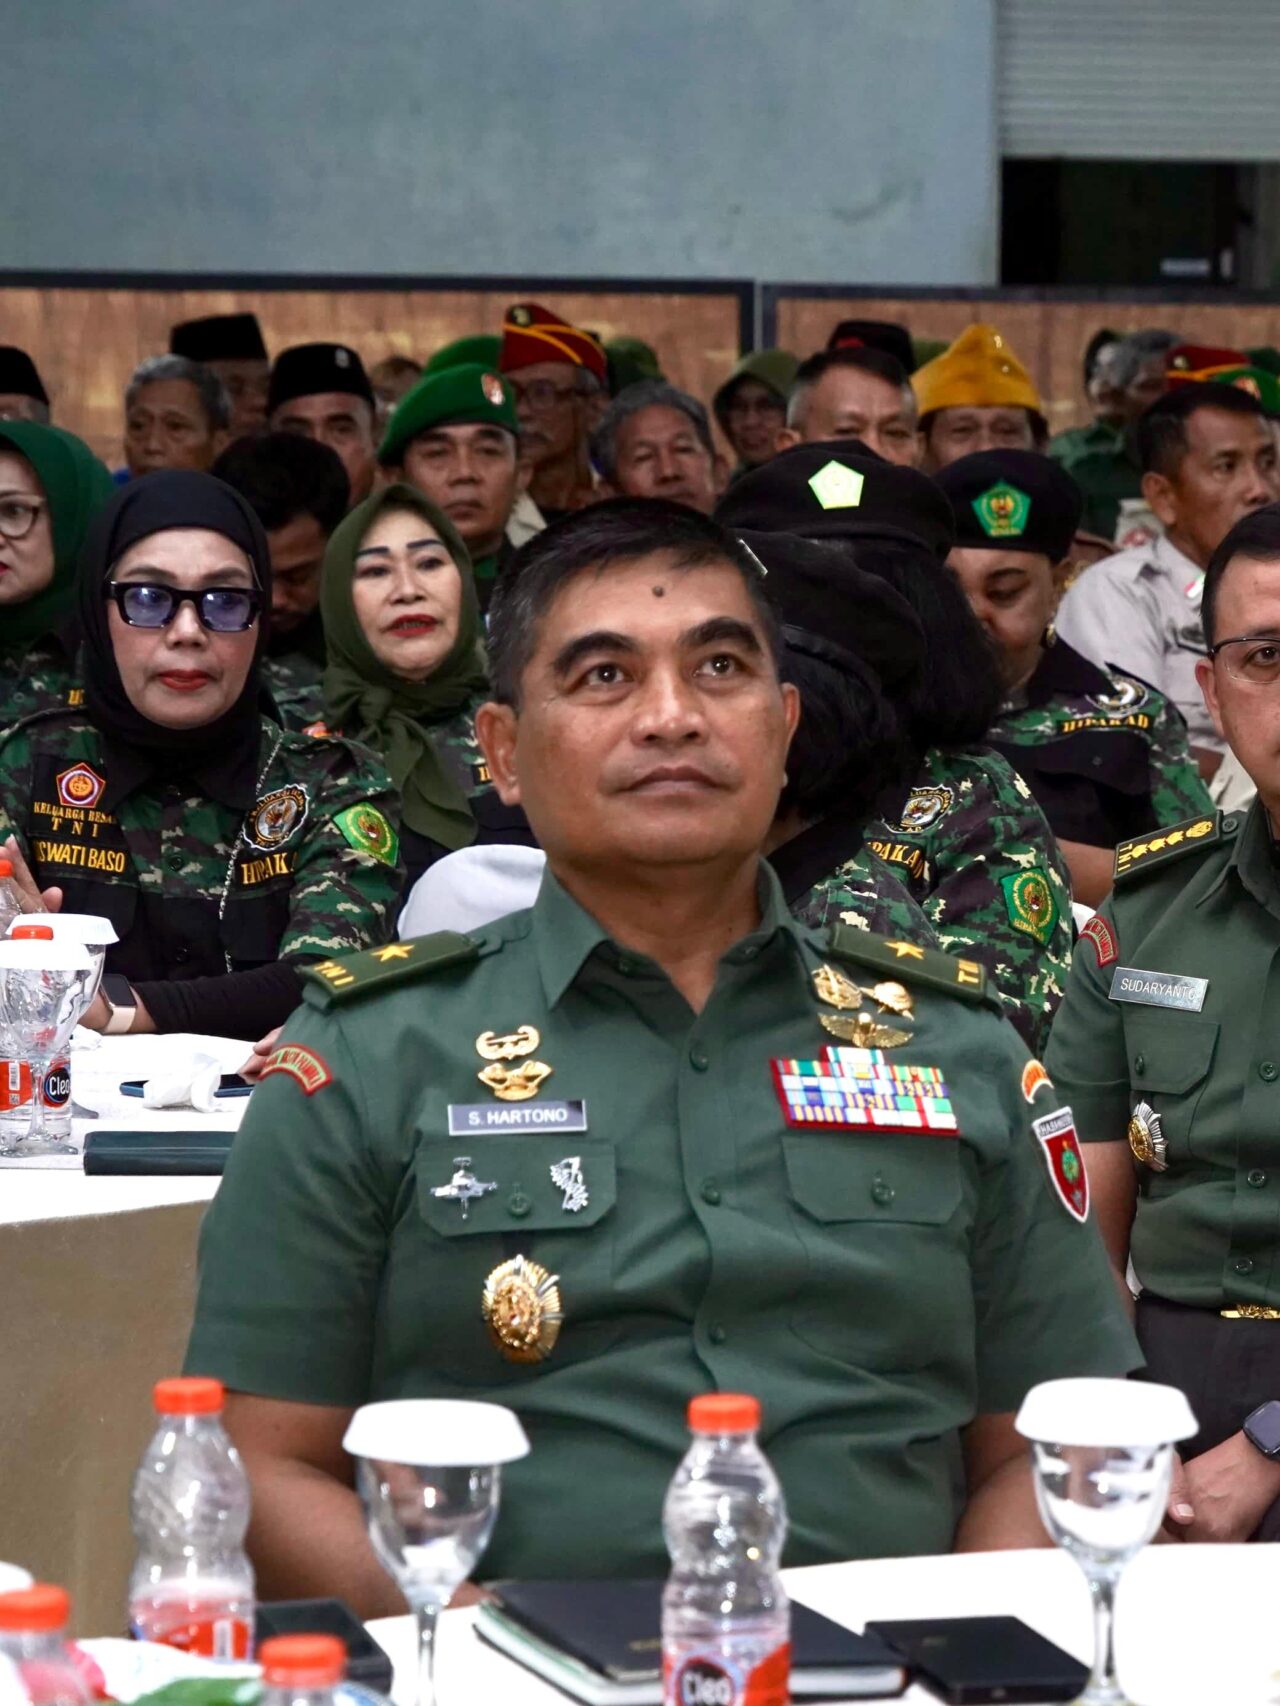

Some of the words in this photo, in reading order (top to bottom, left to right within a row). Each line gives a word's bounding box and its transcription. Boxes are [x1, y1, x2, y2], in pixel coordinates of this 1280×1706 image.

[1063, 714, 1149, 732] HIPAKAD
[87, 847, 125, 873] BASO
[1117, 843, 1134, 872] TNI
[313, 961, 355, 986] TNI
[1120, 977, 1199, 1000] SUDARYANTO
[49, 1076, 70, 1096] Cleo
[487, 1107, 569, 1125] HARTONO
